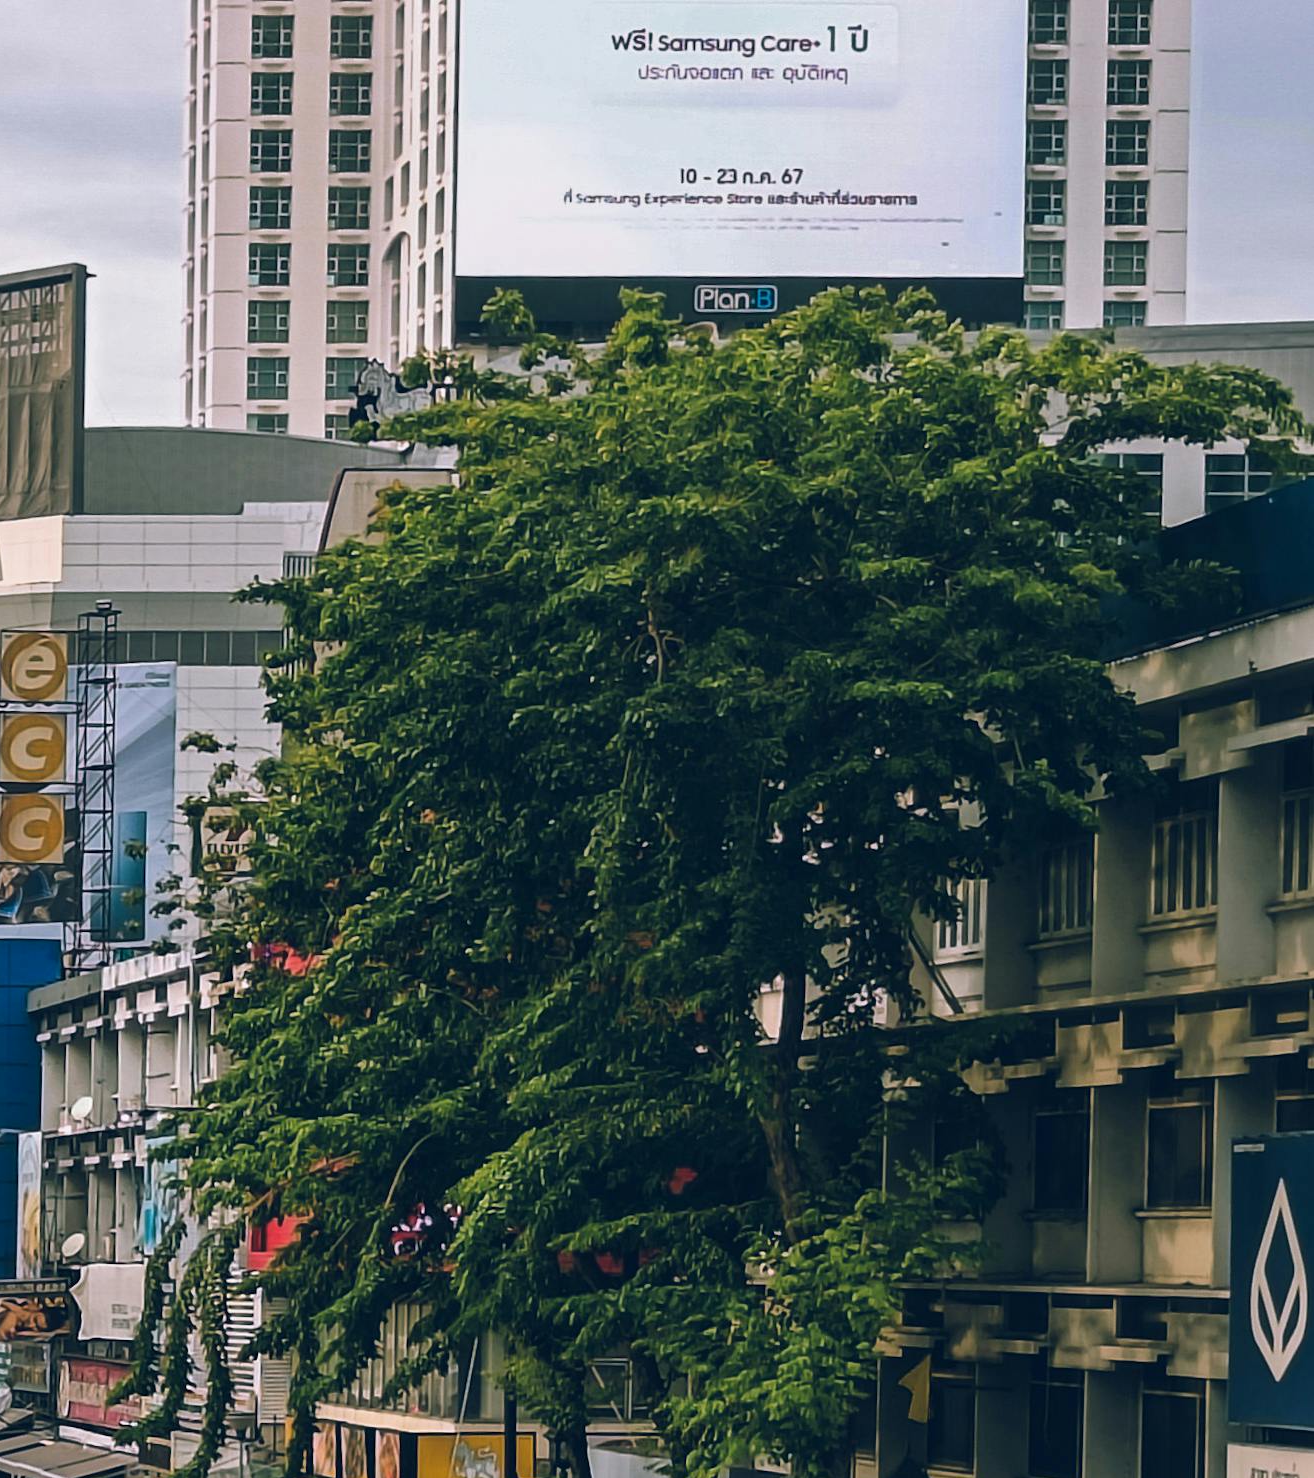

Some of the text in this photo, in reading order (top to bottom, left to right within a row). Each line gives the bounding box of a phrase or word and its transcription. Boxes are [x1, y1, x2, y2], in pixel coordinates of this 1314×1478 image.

[611, 28, 653, 52] ฟรี!
[658, 34, 756, 57] Samsung
[827, 25, 836, 52] 1
[847, 24, 870, 53] ปี
[679, 169, 697, 185] 10
[716, 169, 738, 185] 23
[781, 169, 803, 185] 67
[575, 193, 641, 208] Samsung
[644, 193, 723, 207] Experience
[726, 193, 763, 205] Store
